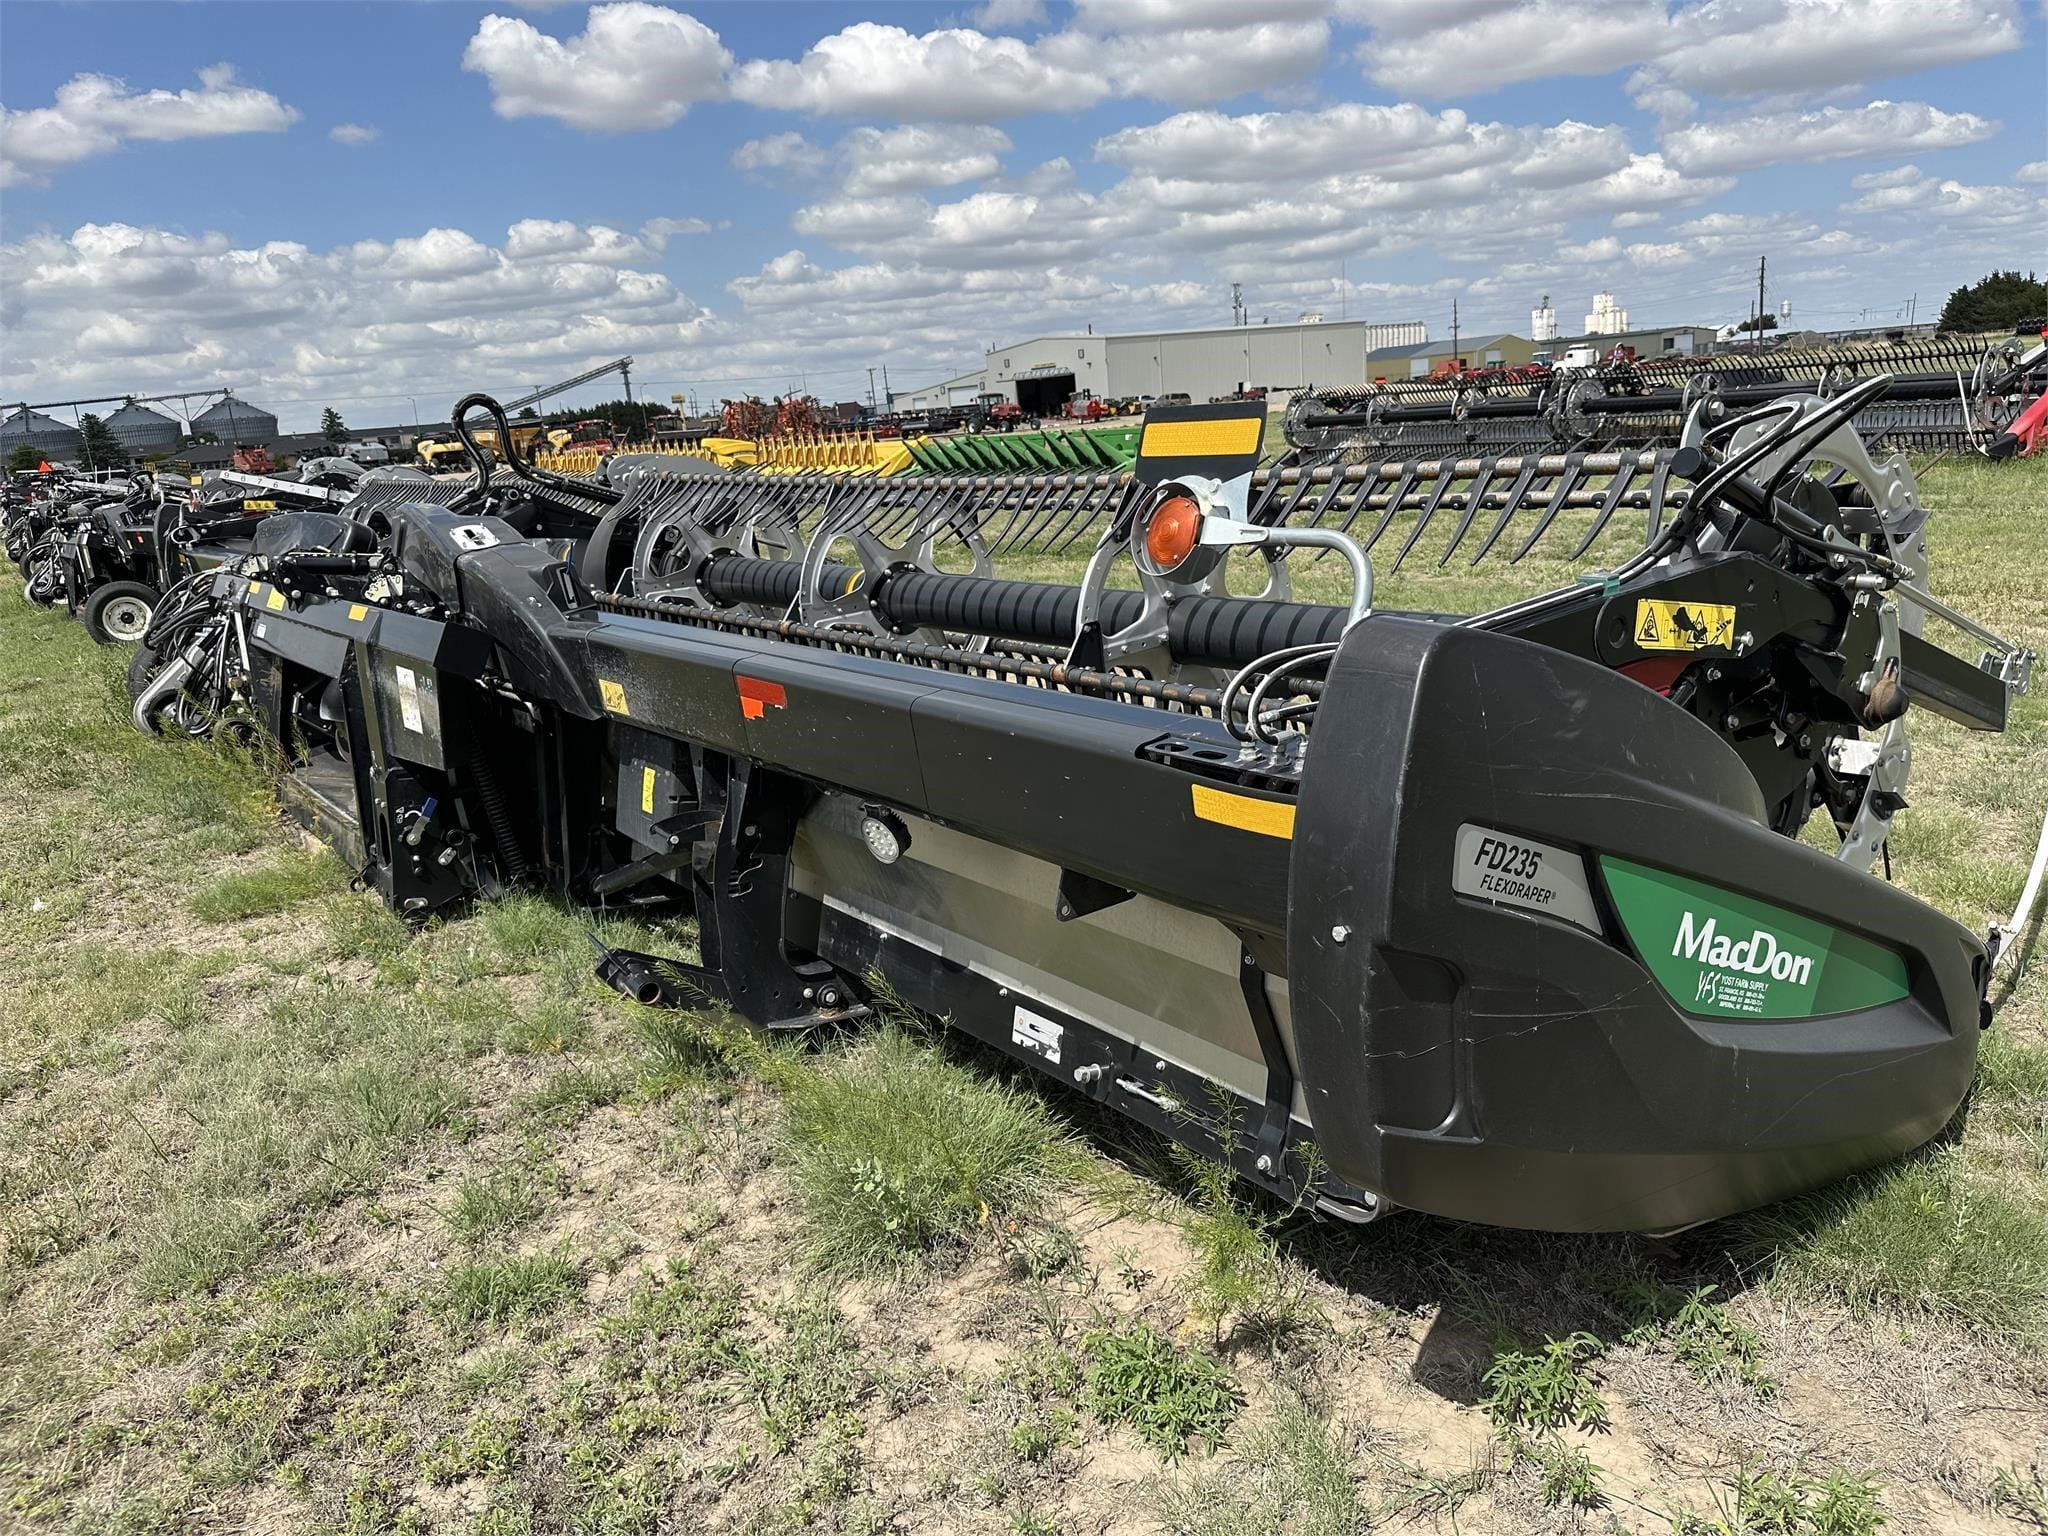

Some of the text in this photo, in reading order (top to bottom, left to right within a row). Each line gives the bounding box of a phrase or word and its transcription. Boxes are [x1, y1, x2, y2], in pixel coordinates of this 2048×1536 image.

[1473, 837, 1543, 880] FD235
[1671, 911, 1812, 985] MacDon
[1721, 975, 1735, 986] YOST
[1749, 980, 1769, 992] SUPPLY
